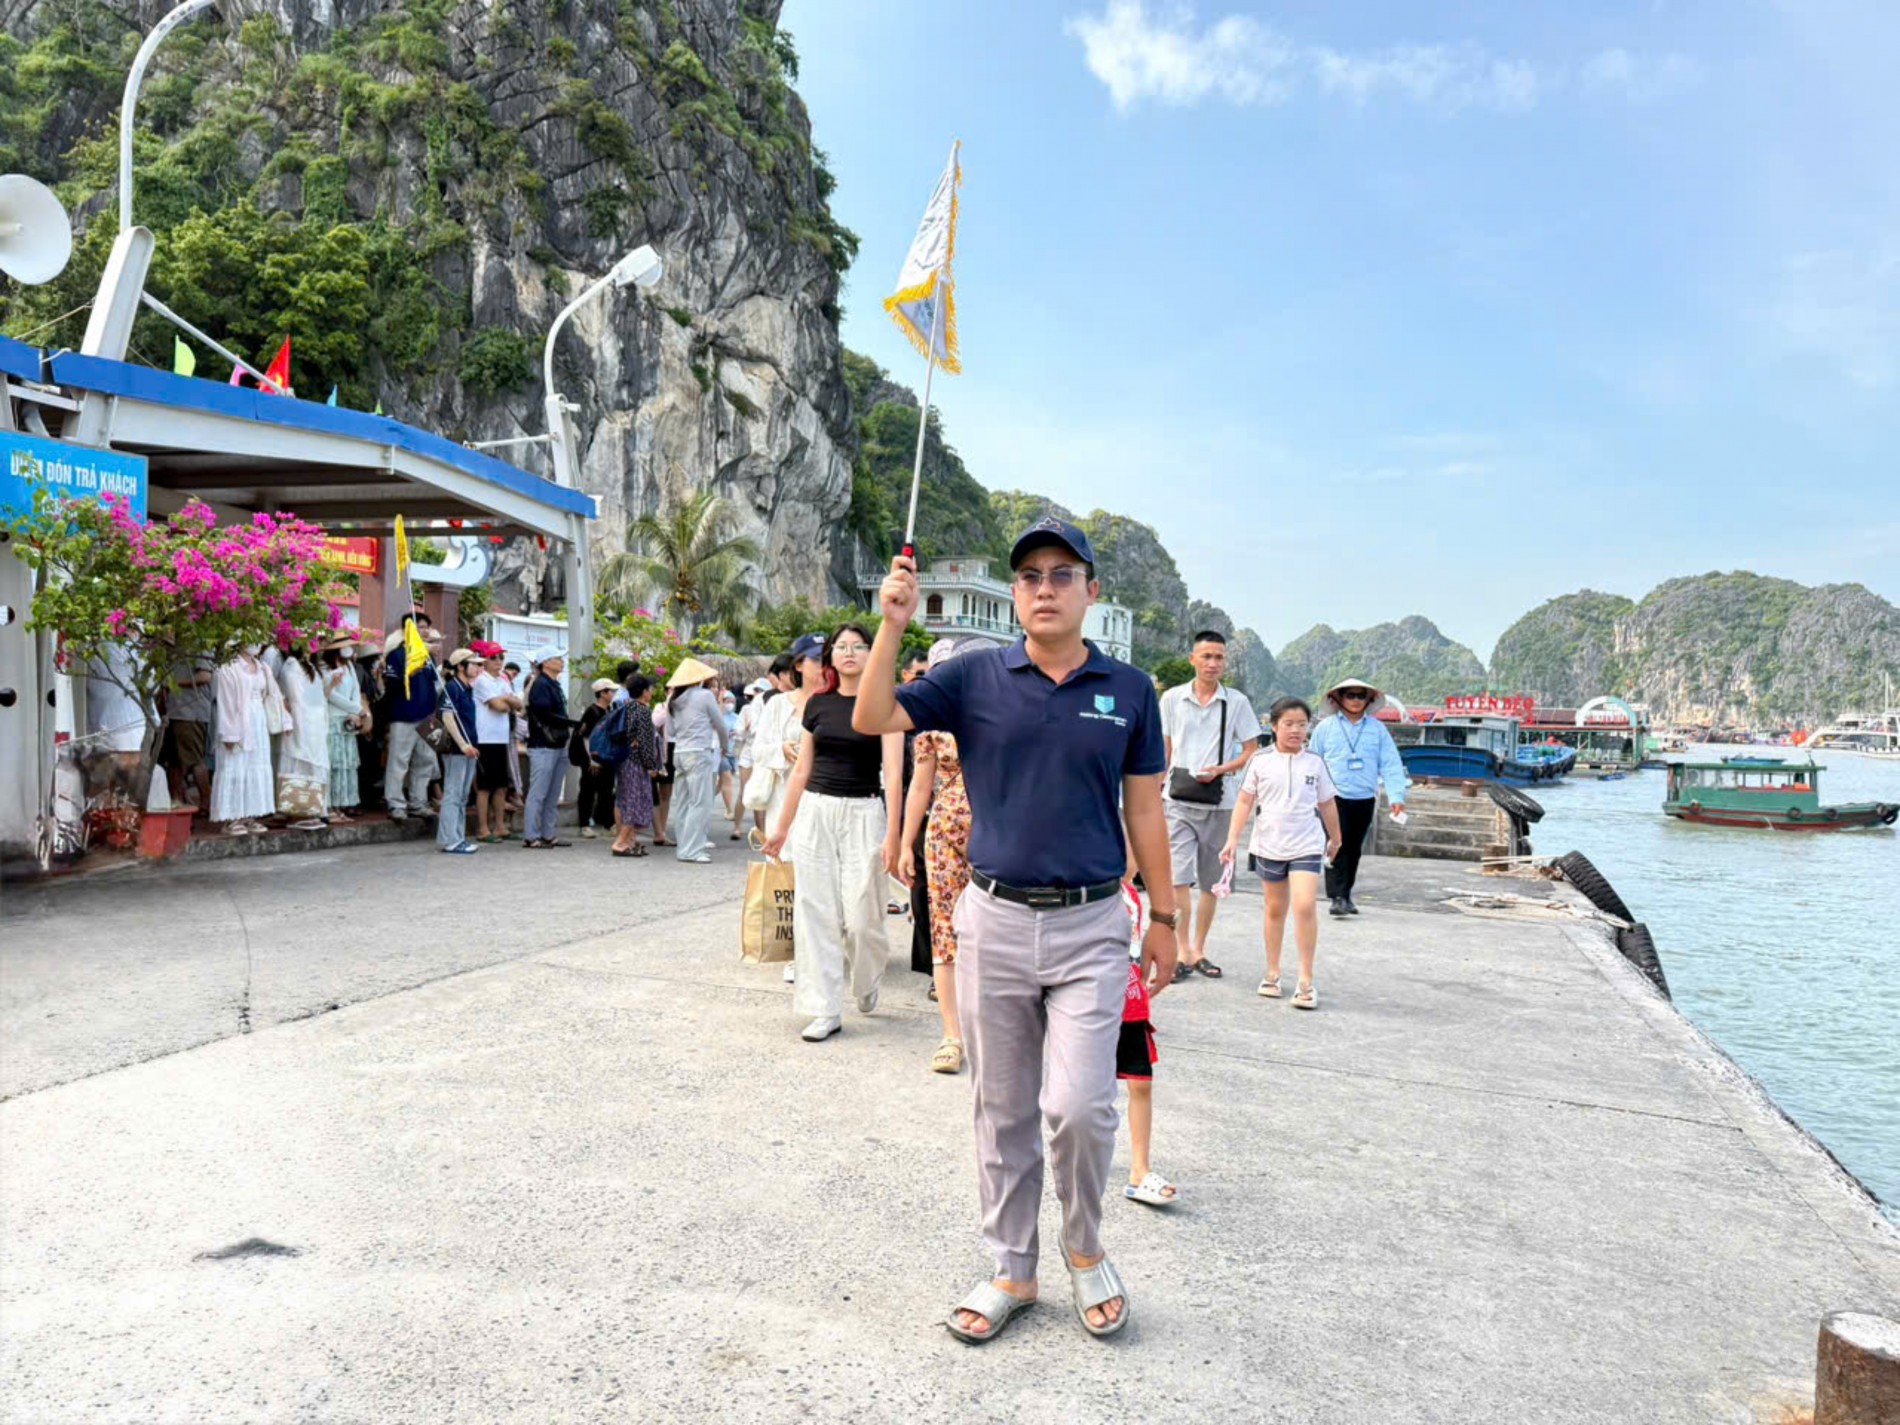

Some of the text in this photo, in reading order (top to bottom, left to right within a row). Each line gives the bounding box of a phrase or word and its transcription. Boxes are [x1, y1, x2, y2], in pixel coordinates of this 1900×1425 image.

[46, 459, 73, 486] ĐÓN
[74, 463, 98, 490] TRẢ
[100, 470, 138, 497] KHÁCH
